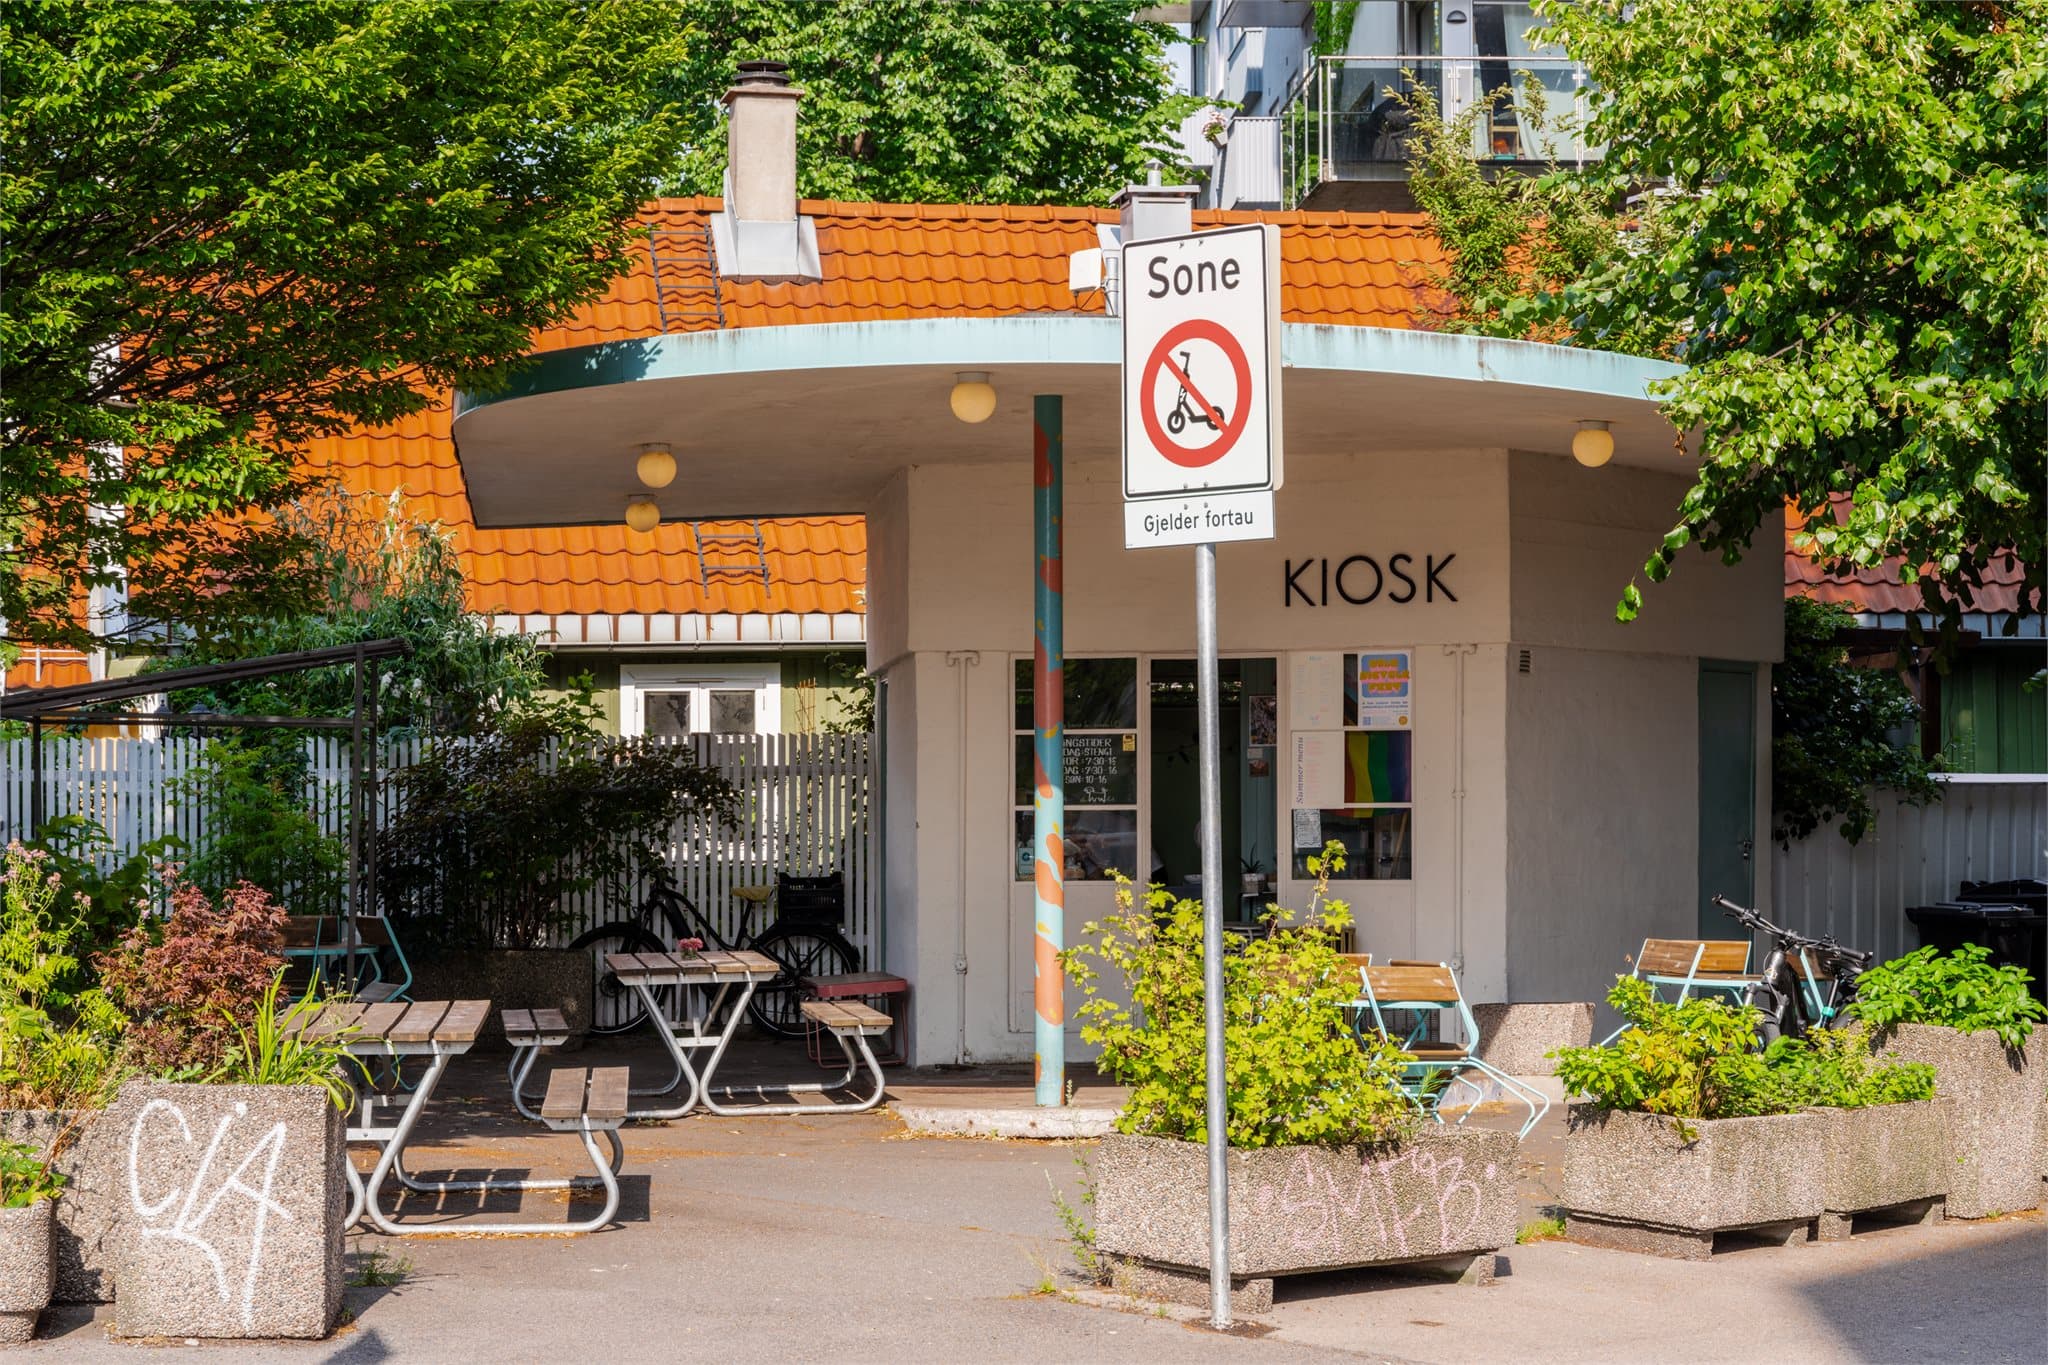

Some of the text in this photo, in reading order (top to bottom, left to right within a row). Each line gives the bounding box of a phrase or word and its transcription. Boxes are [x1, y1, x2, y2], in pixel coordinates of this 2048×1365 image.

[1147, 256, 1241, 299] Sone
[1143, 509, 1254, 536] Gjelder fortau
[1285, 553, 1459, 607] KIOSK
